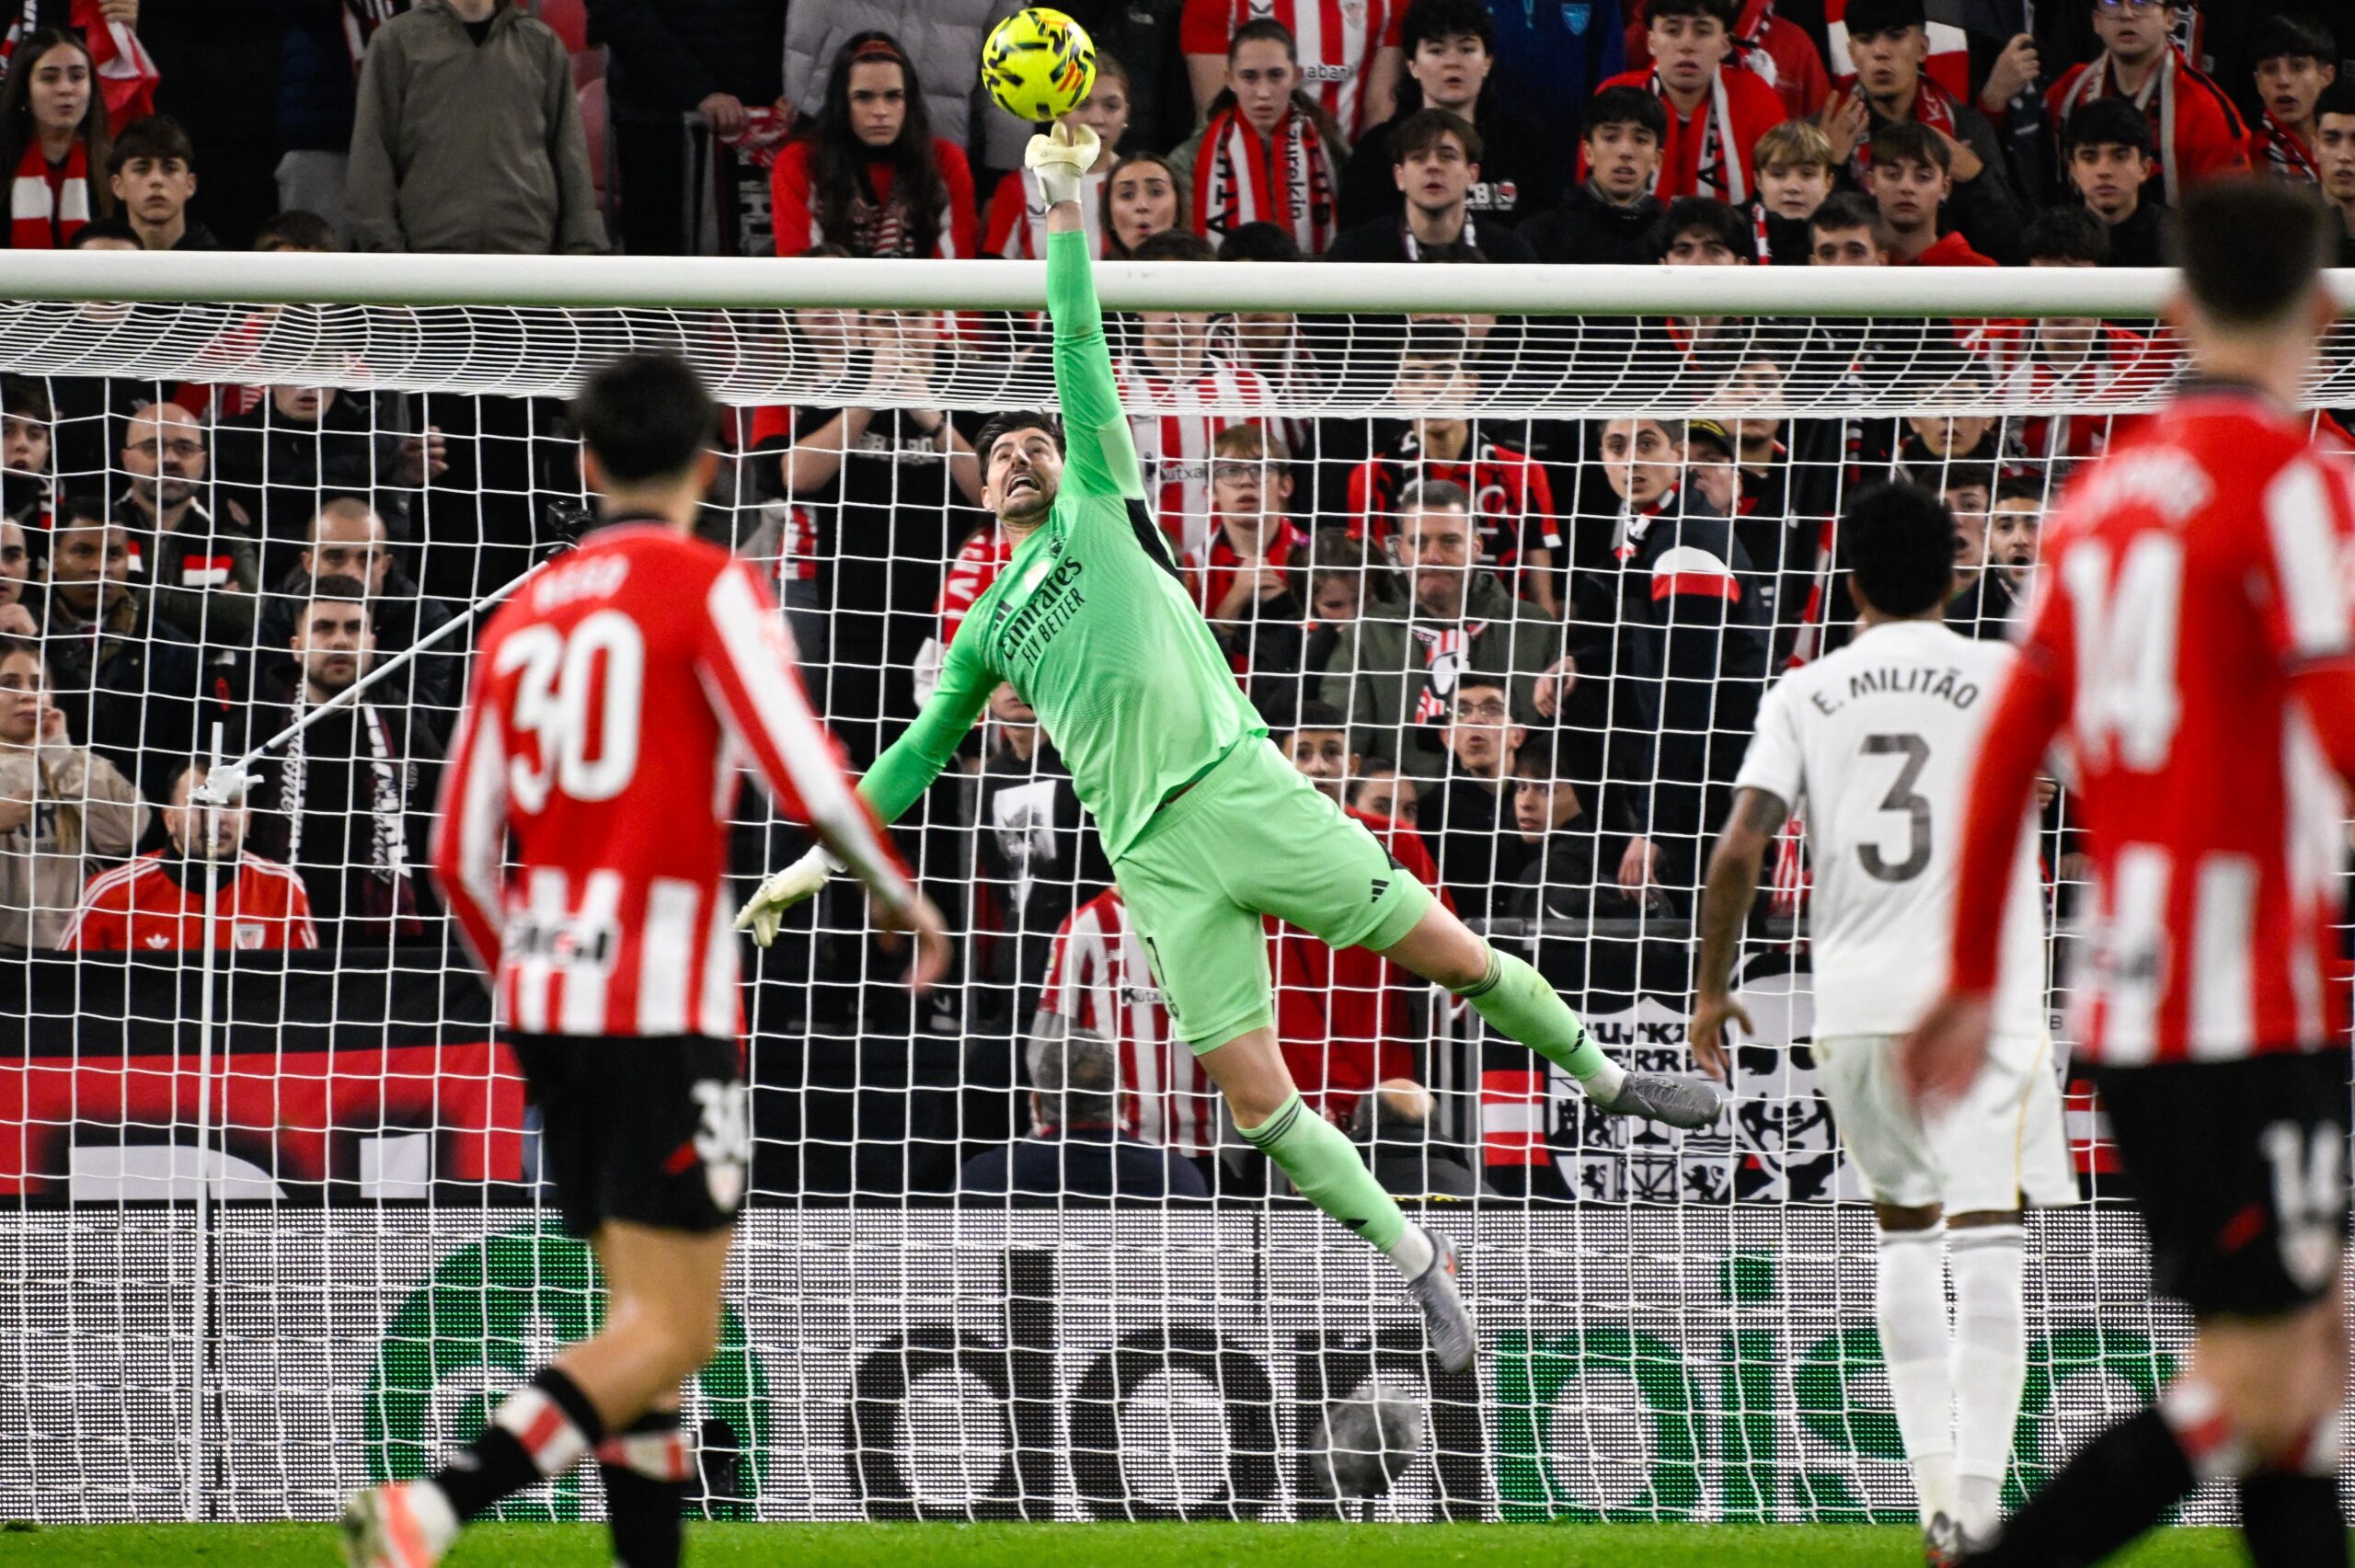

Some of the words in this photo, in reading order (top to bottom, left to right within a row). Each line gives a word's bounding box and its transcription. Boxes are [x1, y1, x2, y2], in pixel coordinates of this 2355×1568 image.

[998, 555, 1083, 661] Emirates
[1021, 635, 1042, 668] FLY
[1038, 587, 1086, 644] BETTER
[2061, 527, 2185, 773] 14
[492, 607, 646, 815] 30
[1811, 691, 1844, 715] E.
[1849, 667, 1980, 710] MILITÃO
[1856, 732, 1933, 884] 3
